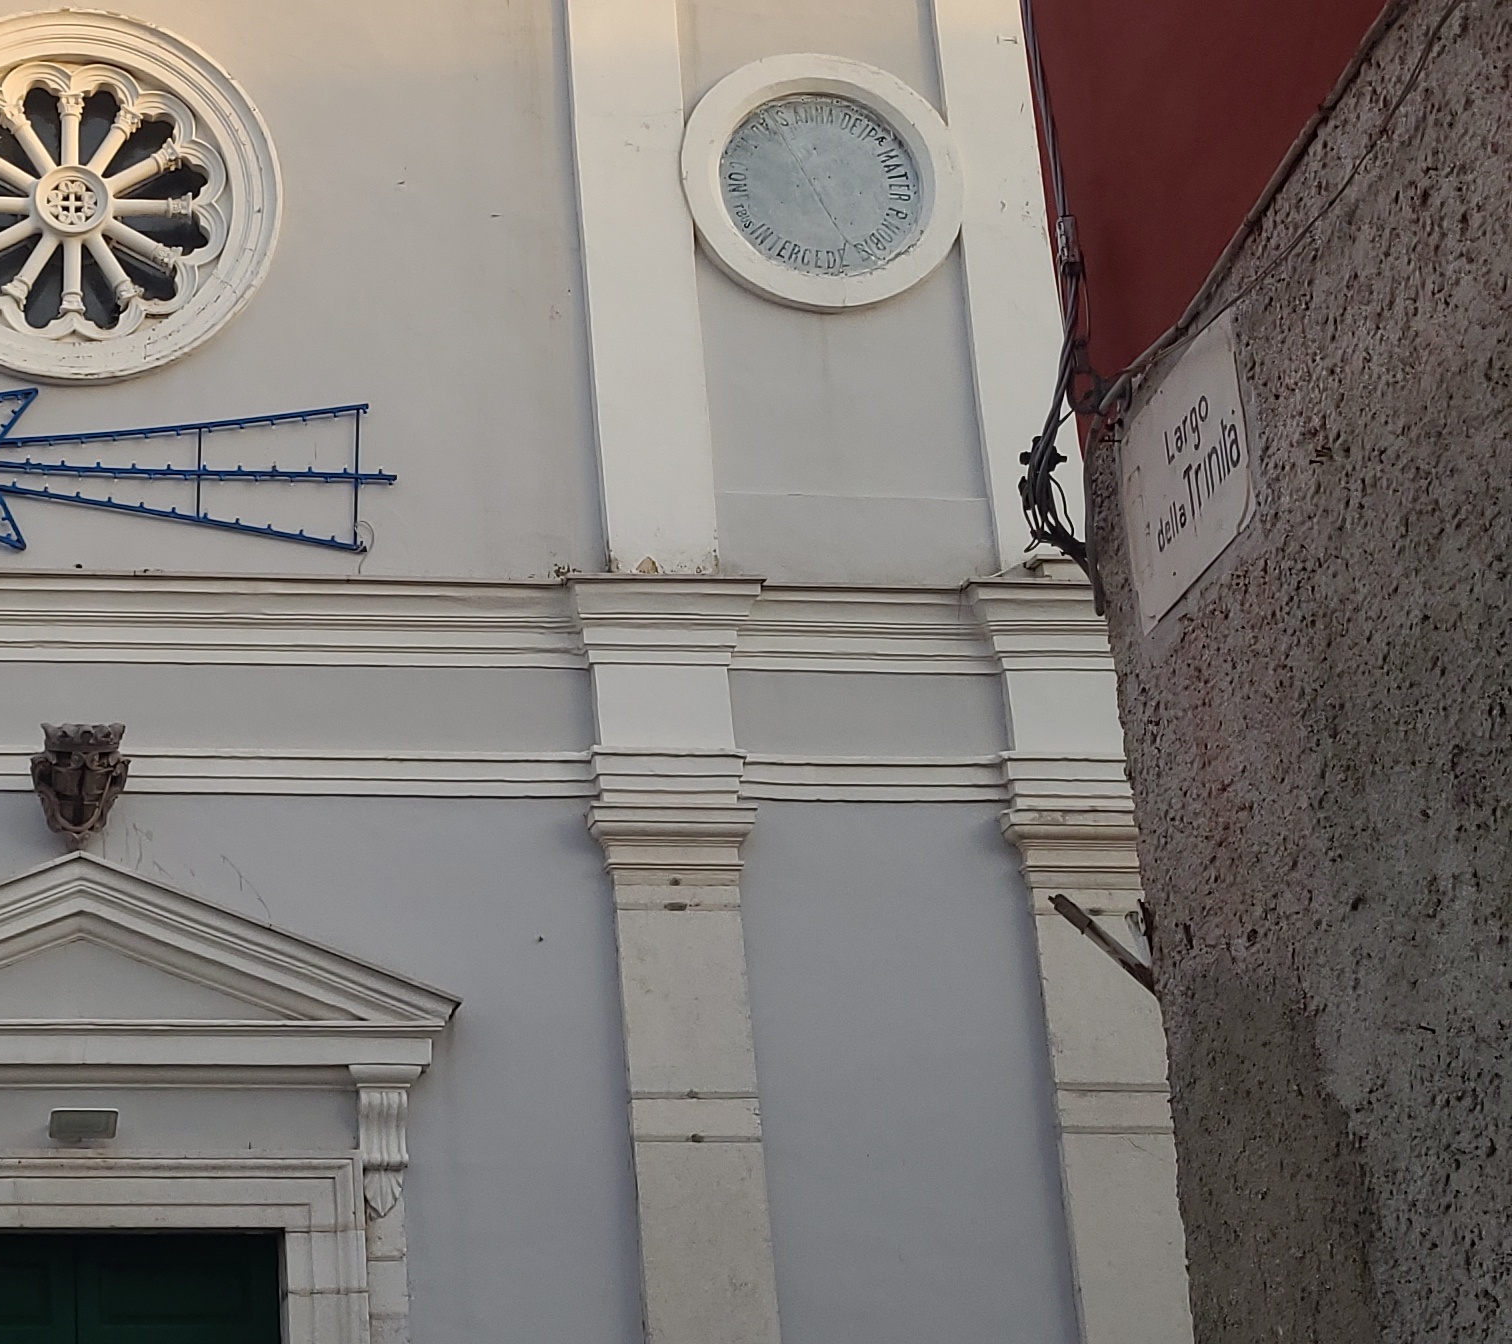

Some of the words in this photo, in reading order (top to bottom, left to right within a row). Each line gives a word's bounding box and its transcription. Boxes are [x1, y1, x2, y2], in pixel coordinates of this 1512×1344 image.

[876, 147, 912, 203] MATER
[1163, 394, 1209, 466] Largo
[1157, 500, 1187, 553] della
